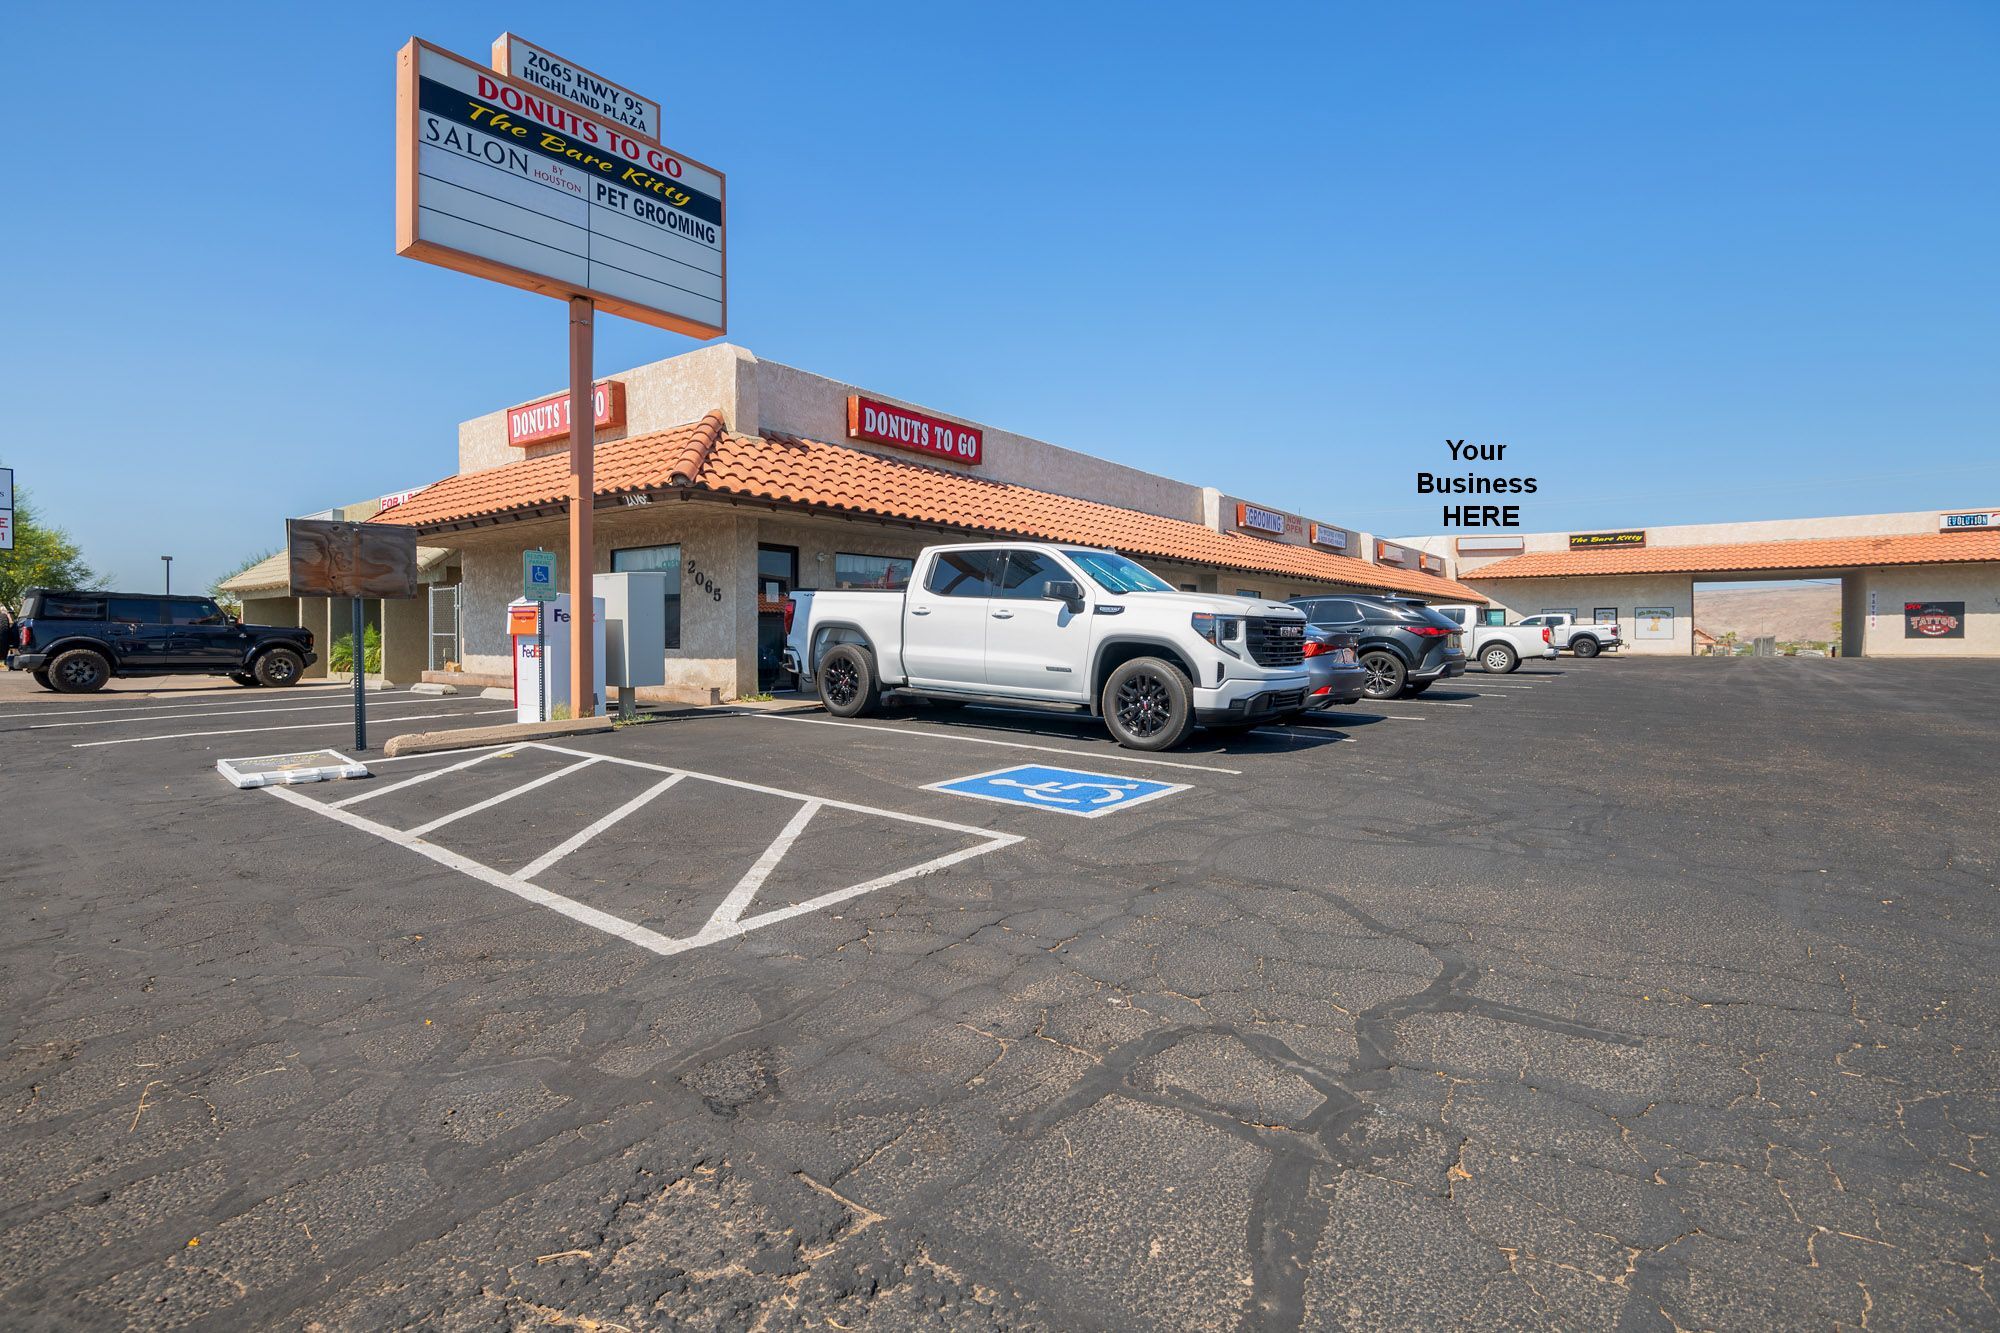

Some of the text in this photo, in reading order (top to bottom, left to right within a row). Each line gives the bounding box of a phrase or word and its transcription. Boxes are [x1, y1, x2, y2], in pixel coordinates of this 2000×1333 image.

[523, 66, 647, 132] HIGHLAND PLAZA
[527, 50, 643, 116] 2065 HWY 95
[477, 74, 683, 179] DONUTS TO GO
[426, 117, 529, 176] SALON
[468, 101, 691, 207] The Bare Kitty
[534, 169, 582, 193] HOUSTON
[552, 164, 564, 176] BY
[596, 182, 716, 244] PET GROOMING
[512, 402, 560, 438] DONUTS
[864, 407, 977, 458] DONUTS TO GO
[1248, 508, 1281, 530] GROOMING
[1286, 523, 1303, 535] OPEN
[1287, 515, 1302, 525] NOW
[1947, 515, 1988, 526] EVOLUTION
[1616, 534, 1643, 542] Kitty
[688, 560, 722, 602] 2065
[1910, 616, 1959, 630] TATTOO
